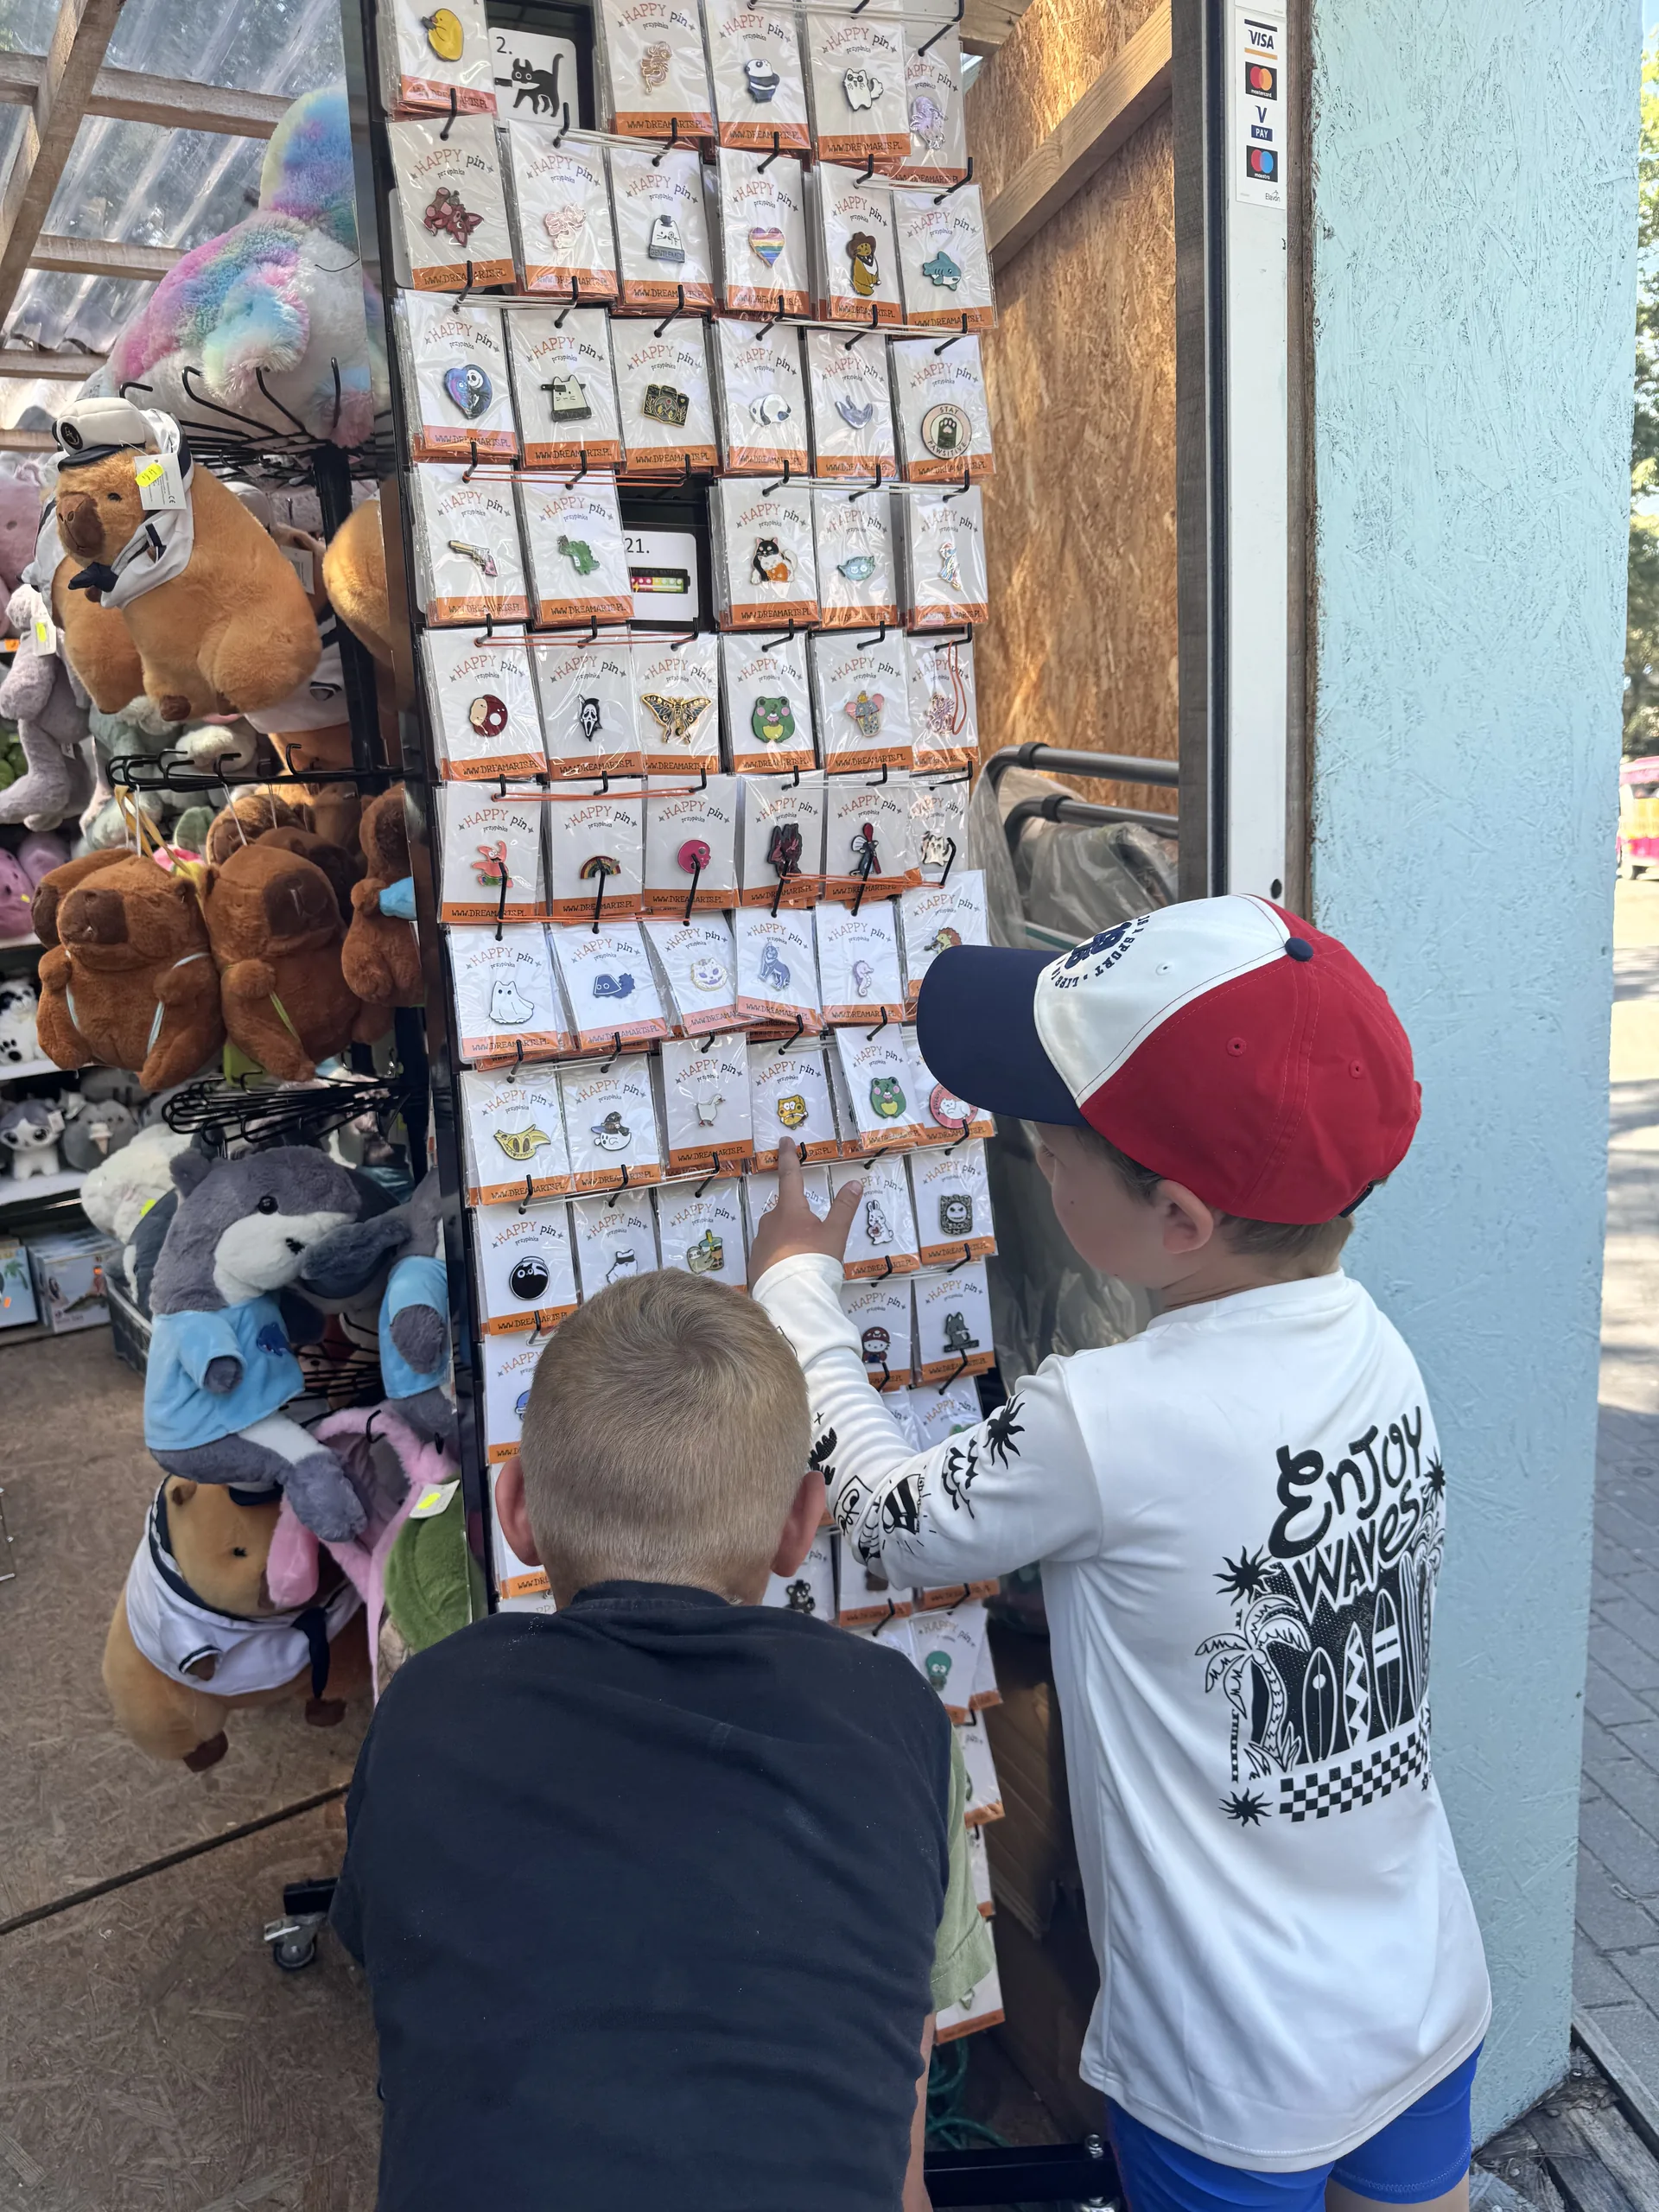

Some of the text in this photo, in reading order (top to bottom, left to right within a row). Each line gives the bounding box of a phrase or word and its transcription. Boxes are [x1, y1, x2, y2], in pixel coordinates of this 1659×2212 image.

[622, 3, 688, 28] HAPPY pin
[723, 15, 785, 40] HAPPY pin
[496, 36, 512, 54] 2.
[827, 27, 890, 50] HAPPY pin
[1249, 29, 1274, 49] VISA
[906, 63, 952, 86] APPY pin
[1251, 89, 1272, 98] mastercard
[1255, 105, 1268, 123] V
[1255, 129, 1268, 139] PAY
[414, 149, 486, 176] HAPPY pin
[531, 155, 593, 182] HAPPY pin
[630, 175, 690, 200] HAPPY pin
[736, 181, 792, 207] HAPPY pin
[835, 196, 884, 221] HAPPY pin
[911, 212, 970, 235] HAPPY pin
[424, 268, 506, 285] WWW.DREAARTS.PL
[429, 322, 493, 347] HAPPY pin
[531, 337, 596, 358] HAPPY pin
[631, 346, 694, 367] HAPPY pin
[776, 357, 791, 373] pin
[864, 365, 878, 378] pin
[914, 363, 972, 385] HAPPY pin
[940, 406, 959, 415] STAY
[536, 448, 611, 459] WWW.DREAMRTS.PL
[636, 451, 709, 463] WWW.DREAMATS.PL
[928, 440, 967, 456] PAWSITIVE
[441, 493, 503, 514] HAPPY pin
[543, 496, 607, 517] HAPPY pin
[740, 504, 799, 524] HAPPY pin
[868, 516, 881, 531] pin
[625, 537, 650, 554] 21.
[454, 655, 518, 677] HAPPY pin
[601, 661, 619, 674] pin
[648, 658, 706, 681] HAPPY pin
[741, 658, 796, 677] HAPPY pin
[836, 658, 893, 678] HAPPY pin
[664, 801, 724, 821] HAPPY pin
[798, 801, 812, 813] pin
[842, 795, 897, 814] HAPPY pin
[464, 809, 527, 832] HAPPY pin
[569, 806, 631, 826] HAPPY pin
[563, 901, 633, 912] WWW.DREMARTS.PL
[652, 895, 723, 904] WWW.DREAARTS.PL
[918, 894, 973, 913] HAPPY pin
[668, 928, 721, 948] HAPPY pin
[752, 923, 803, 945] HAPPY pin
[831, 923, 885, 939] HAPPY pin
[471, 947, 534, 967] HAPPY pin
[574, 938, 632, 960] HAPPY pin
[1095, 938, 1135, 977] SPORT
[855, 1046, 898, 1064] HAPPY pin
[680, 1060, 736, 1079] HAPPY pin
[759, 1061, 815, 1083] HAPPY pin
[579, 1080, 639, 1099] HAPPY pin
[486, 1091, 547, 1111] HAPPY pin
[963, 1164, 976, 1175] pin
[884, 1179, 897, 1190] pin
[675, 1204, 729, 1223] HAPPY pin
[495, 1222, 556, 1243] HAPPY pin
[590, 1214, 641, 1235] HAPPY pin
[964, 1283, 977, 1294] pin
[888, 1297, 901, 1308] pin
